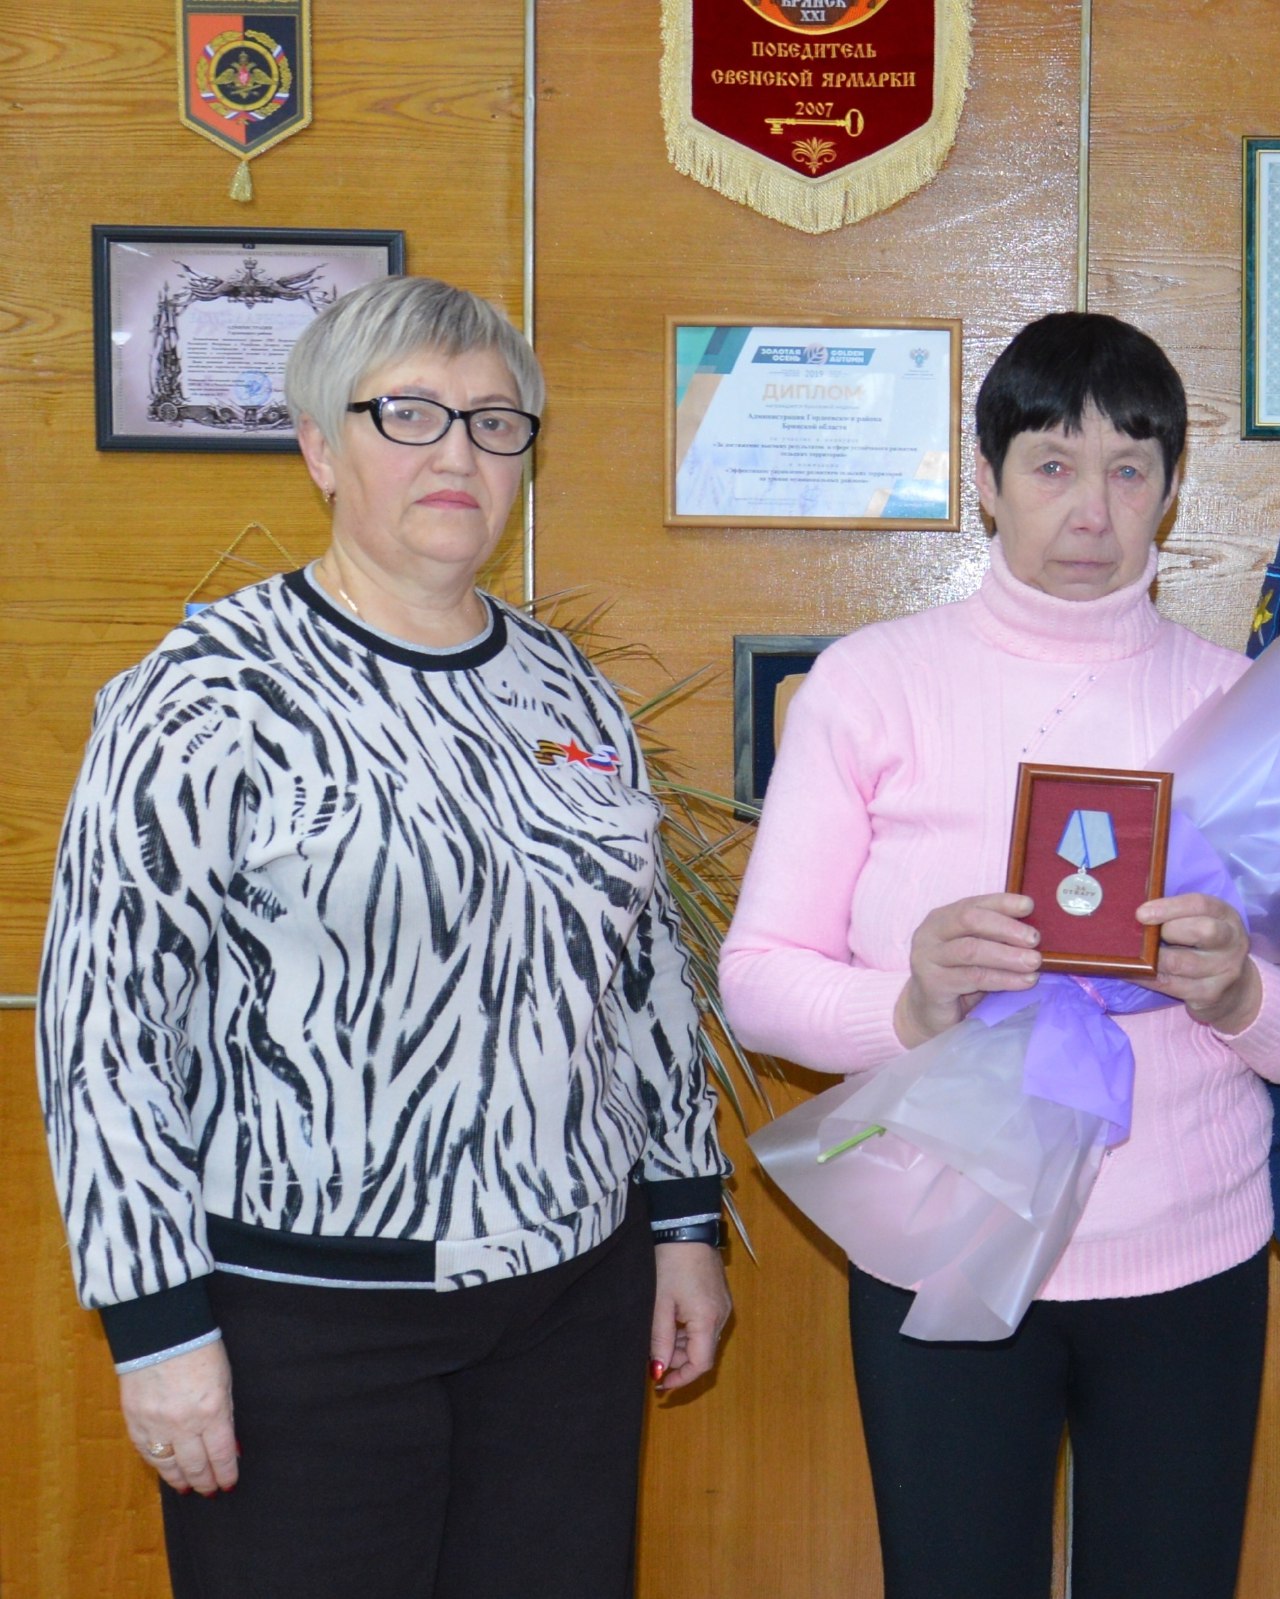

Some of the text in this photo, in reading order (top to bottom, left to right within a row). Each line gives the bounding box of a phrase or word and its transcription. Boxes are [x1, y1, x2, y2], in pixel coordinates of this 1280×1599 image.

[800, 10, 826, 22] XXI
[751, 42, 877, 61] ПОБЕДИТЕЛЬ
[711, 69, 916, 88] СВЕНСКОЙ ЯРМАРКИ
[794, 102, 834, 117] 2007
[805, 370, 825, 378] 2019
[763, 383, 863, 402] ДИПЛОМ
